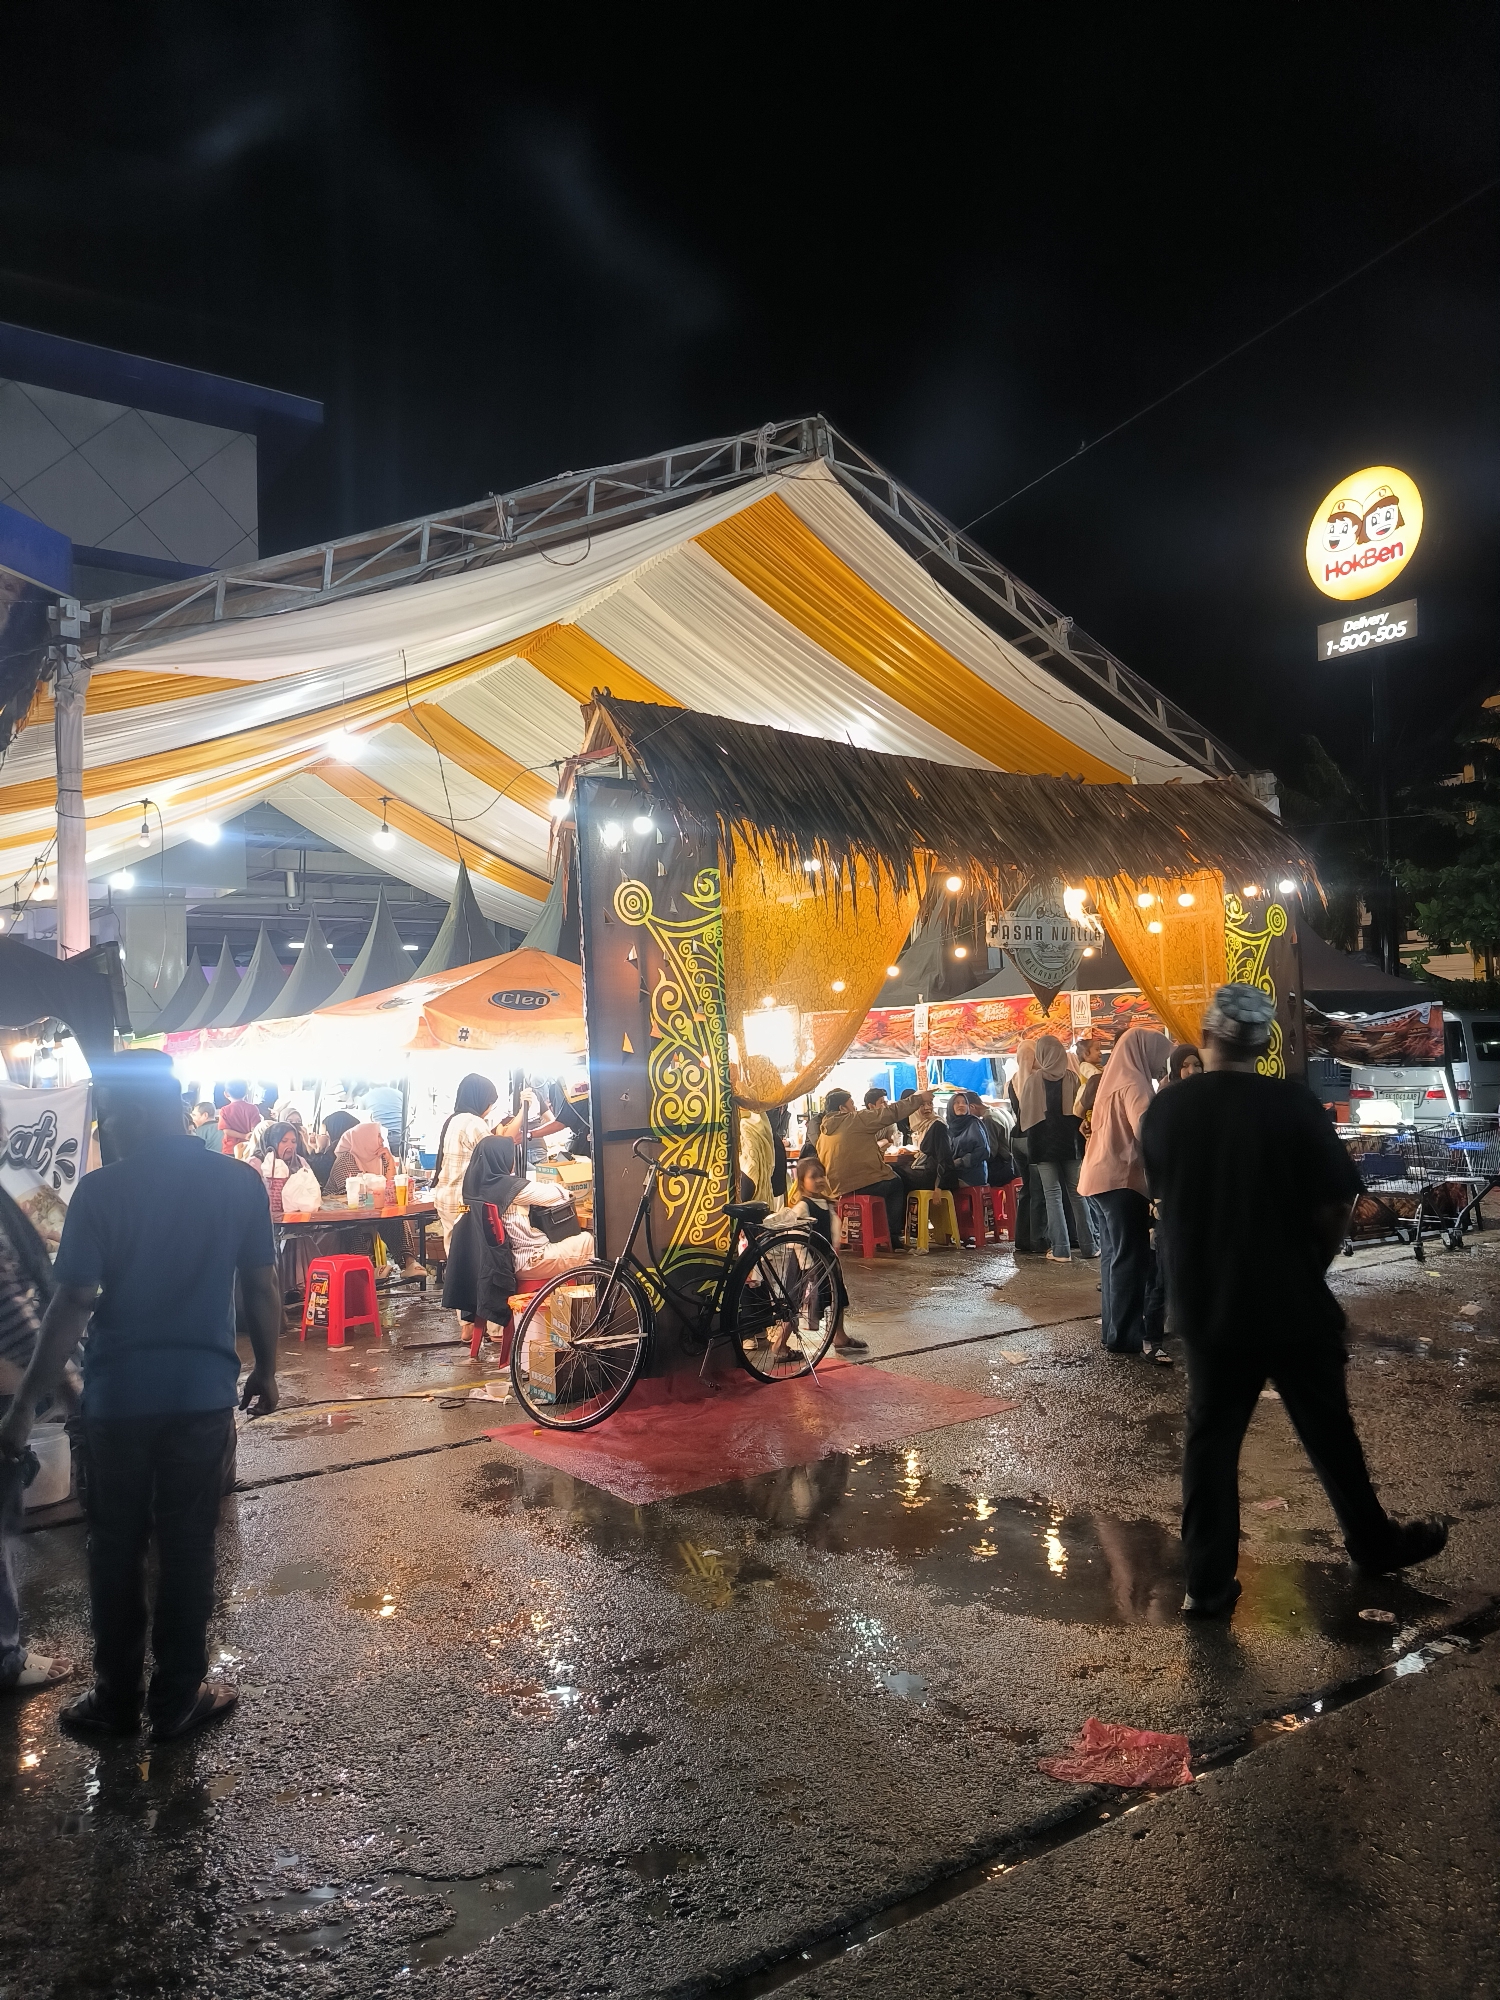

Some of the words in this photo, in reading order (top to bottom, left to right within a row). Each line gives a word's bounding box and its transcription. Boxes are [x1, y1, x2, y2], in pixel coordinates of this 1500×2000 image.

[1325, 541, 1404, 582] HokBen
[1343, 611, 1390, 634] Delivery
[1326, 620, 1408, 656] 1-500-505
[990, 924, 1043, 941] PASAR
[1051, 925, 1101, 942] NURLELA
[501, 993, 548, 1006] Cleo
[1029, 1000, 1060, 1012] ODG
[929, 1007, 965, 1021] TOPPOKI
[976, 1002, 1005, 1013] BAKSO
[984, 1007, 1010, 1016] BAKAR
[982, 1013, 1009, 1022] JUMBO
[2, 1110, 57, 1177] at
